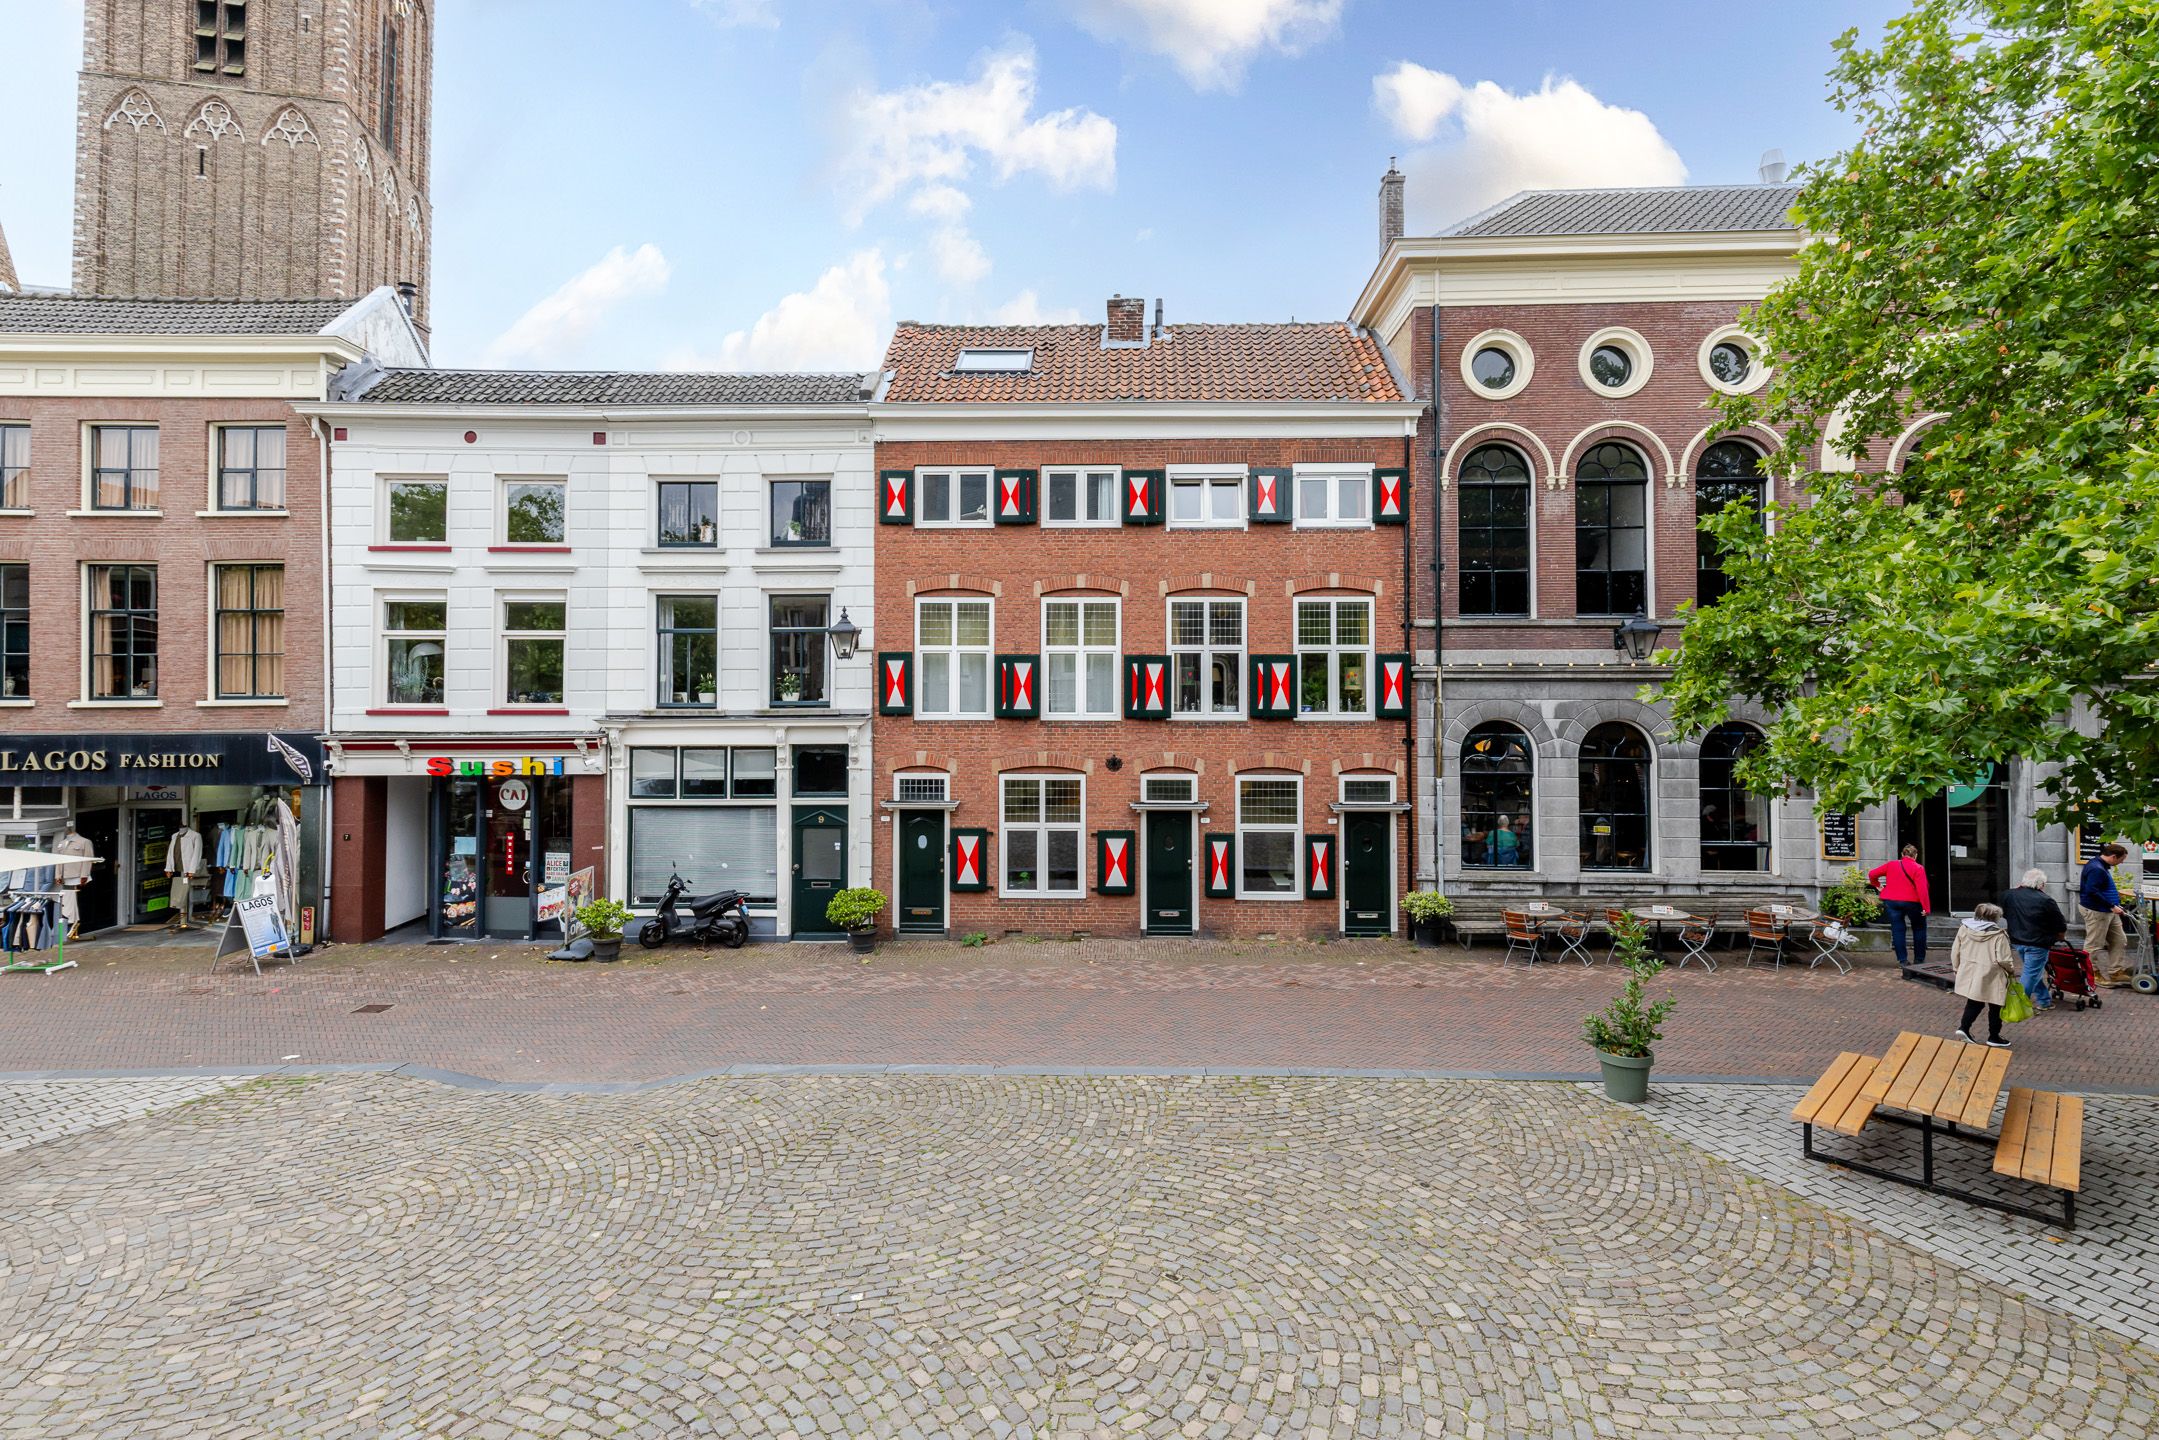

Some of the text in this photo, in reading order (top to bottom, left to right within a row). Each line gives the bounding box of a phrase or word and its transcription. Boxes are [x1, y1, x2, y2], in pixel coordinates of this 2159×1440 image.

[0, 750, 220, 771] LAGOS FASHION
[426, 756, 564, 777] Sushi
[135, 791, 178, 800] LAGOS
[500, 788, 527, 801] CAI
[818, 816, 824, 824] 9
[241, 896, 274, 912] LAGOS
